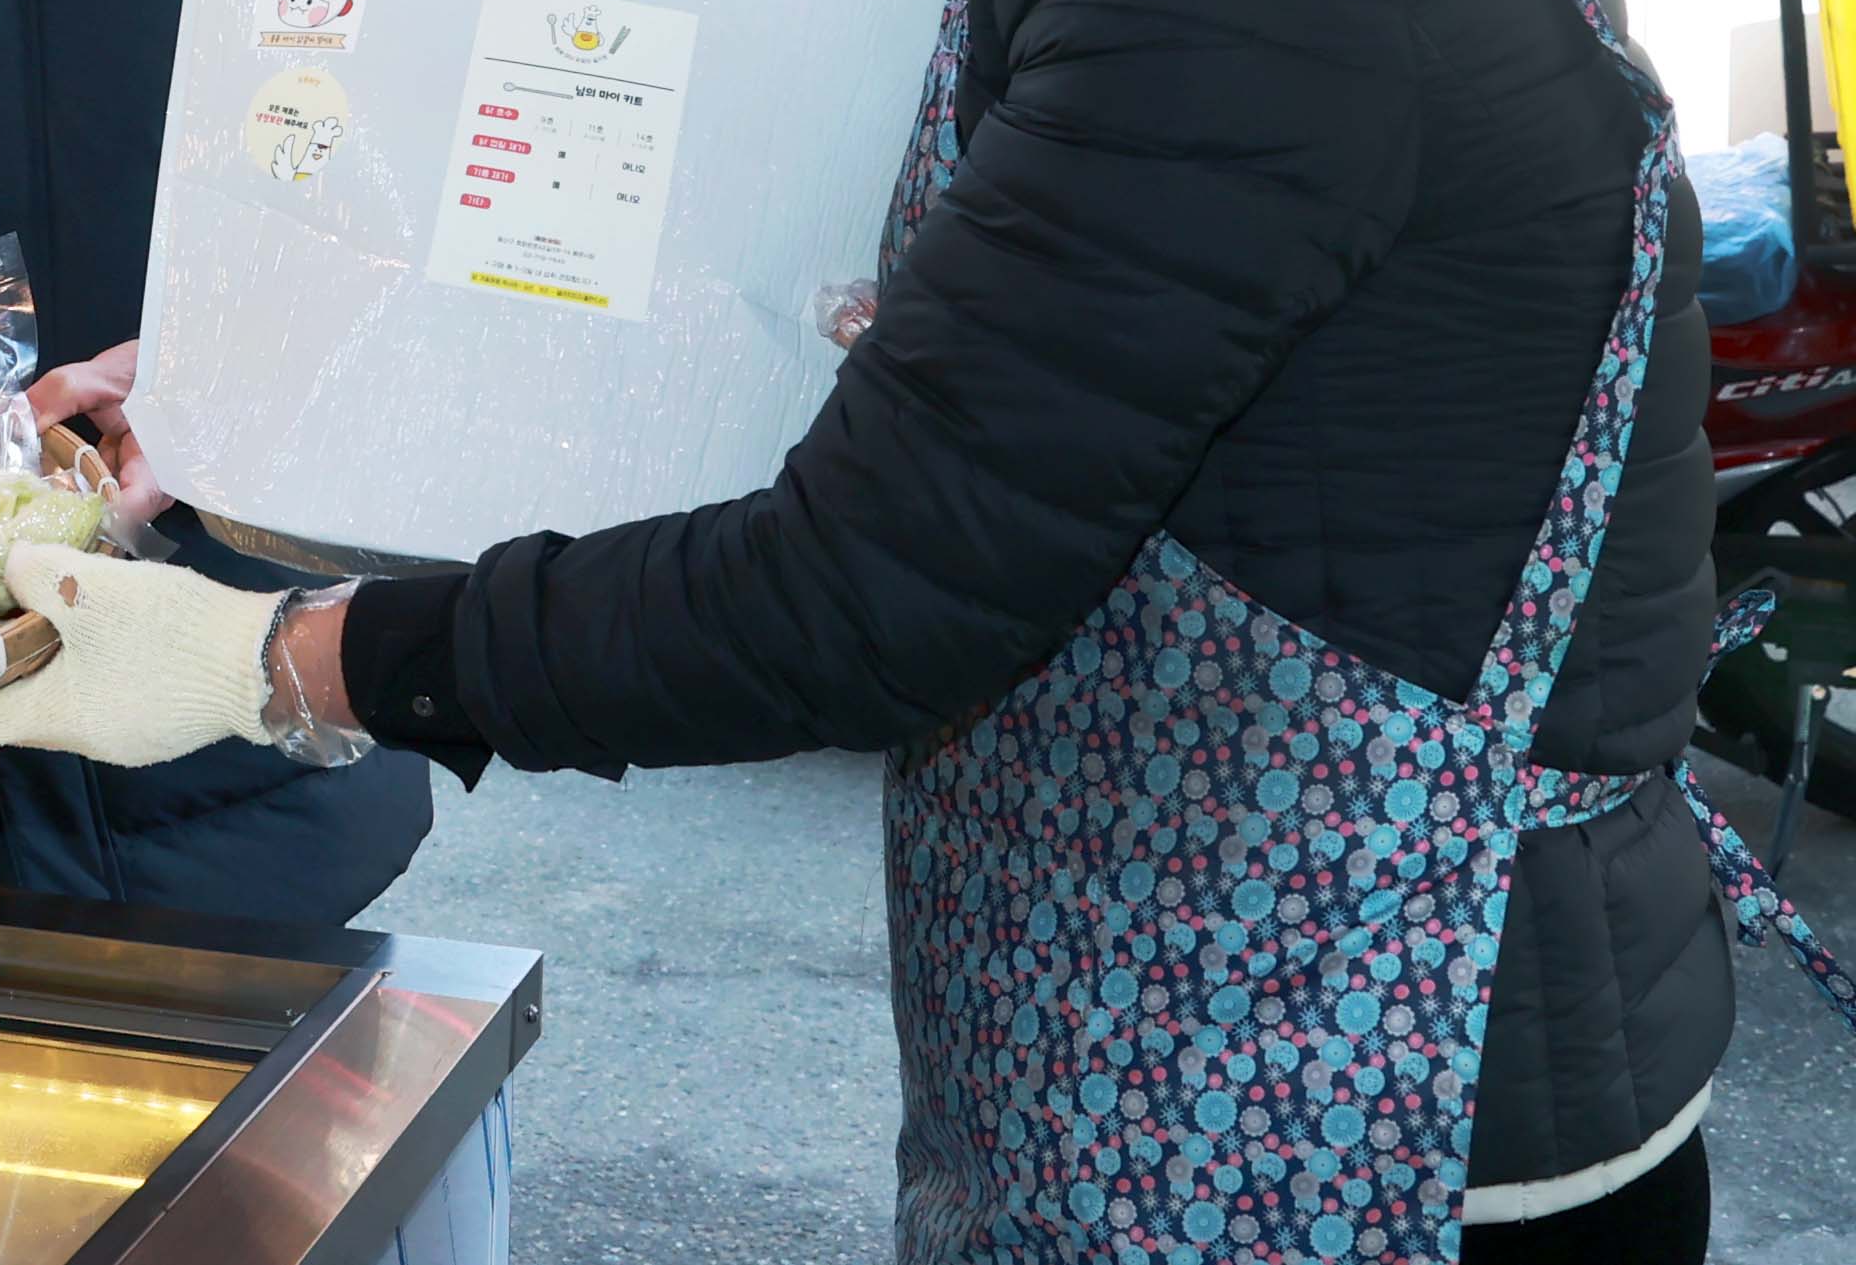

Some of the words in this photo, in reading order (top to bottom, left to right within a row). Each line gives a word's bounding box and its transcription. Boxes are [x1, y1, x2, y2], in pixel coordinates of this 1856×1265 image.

[575, 85, 596, 99] 님의
[598, 90, 620, 103] 마이
[623, 94, 644, 107] 키트
